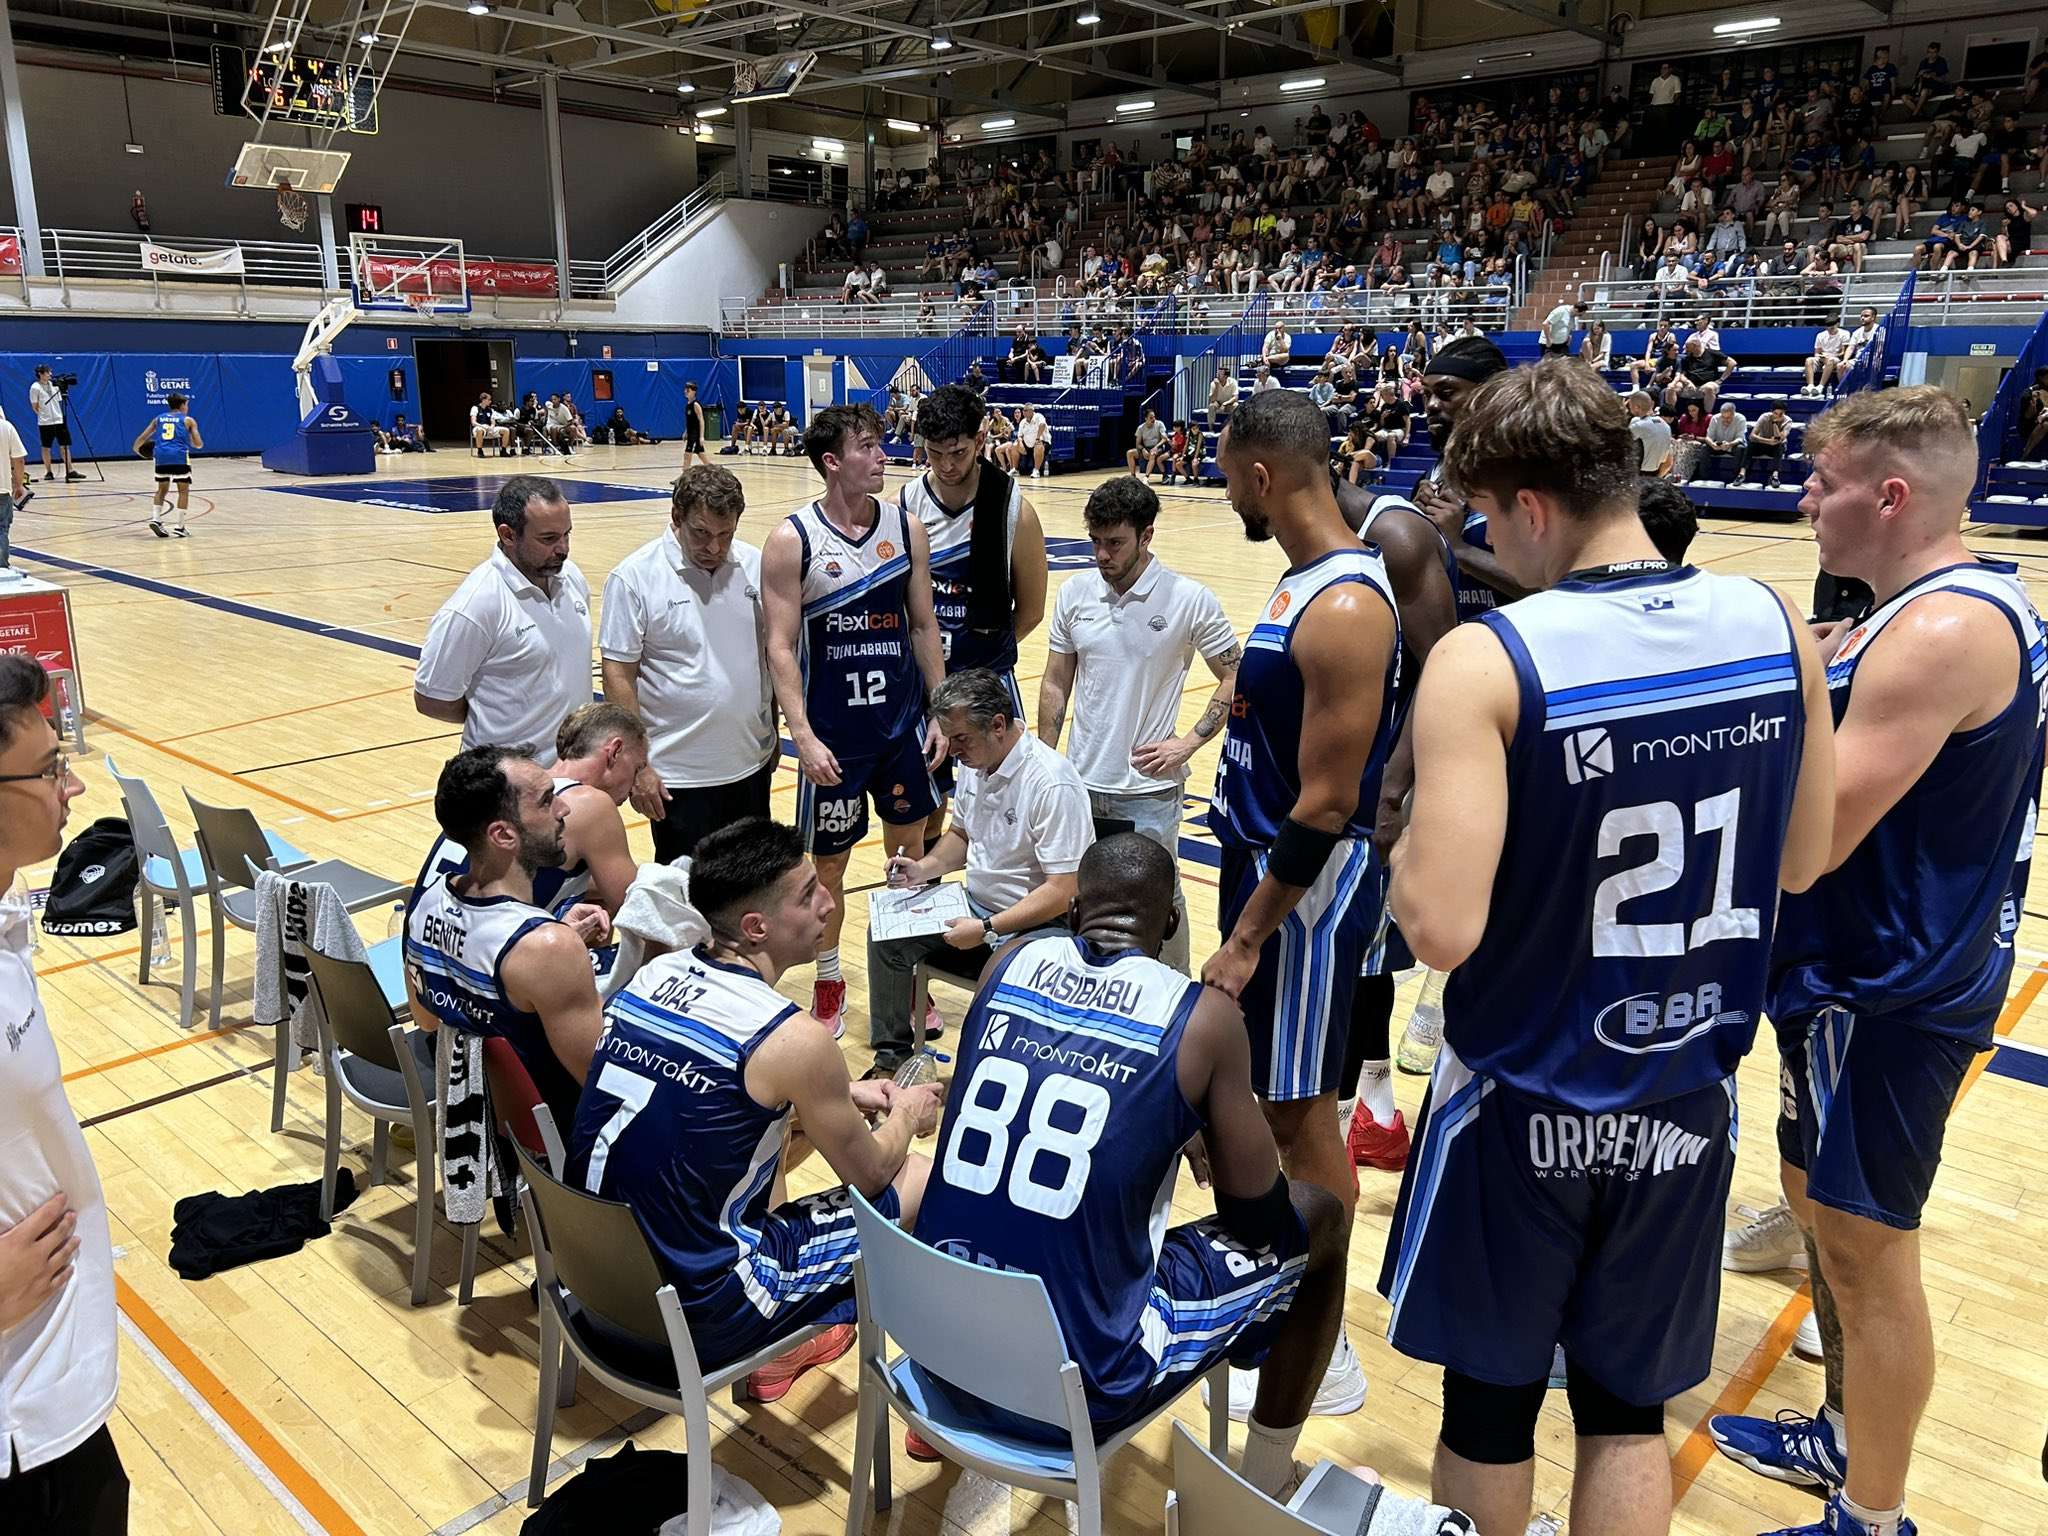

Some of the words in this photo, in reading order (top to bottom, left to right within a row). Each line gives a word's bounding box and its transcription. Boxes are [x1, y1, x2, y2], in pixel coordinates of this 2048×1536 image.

[361, 209, 378, 230] 14
[1089, 358, 1098, 366] 23
[160, 381, 191, 390] GETAFE
[161, 423, 175, 440] 3
[1608, 561, 1643, 573] NIKE
[1643, 560, 1669, 570] PRO
[845, 670, 887, 707] 12
[1592, 786, 1760, 958] 21
[422, 914, 467, 959] BENITE
[649, 974, 708, 1014] DÍAZ
[1028, 957, 1144, 1016] KASIBABU
[585, 1061, 657, 1195] 7
[942, 1055, 1111, 1220] 88
